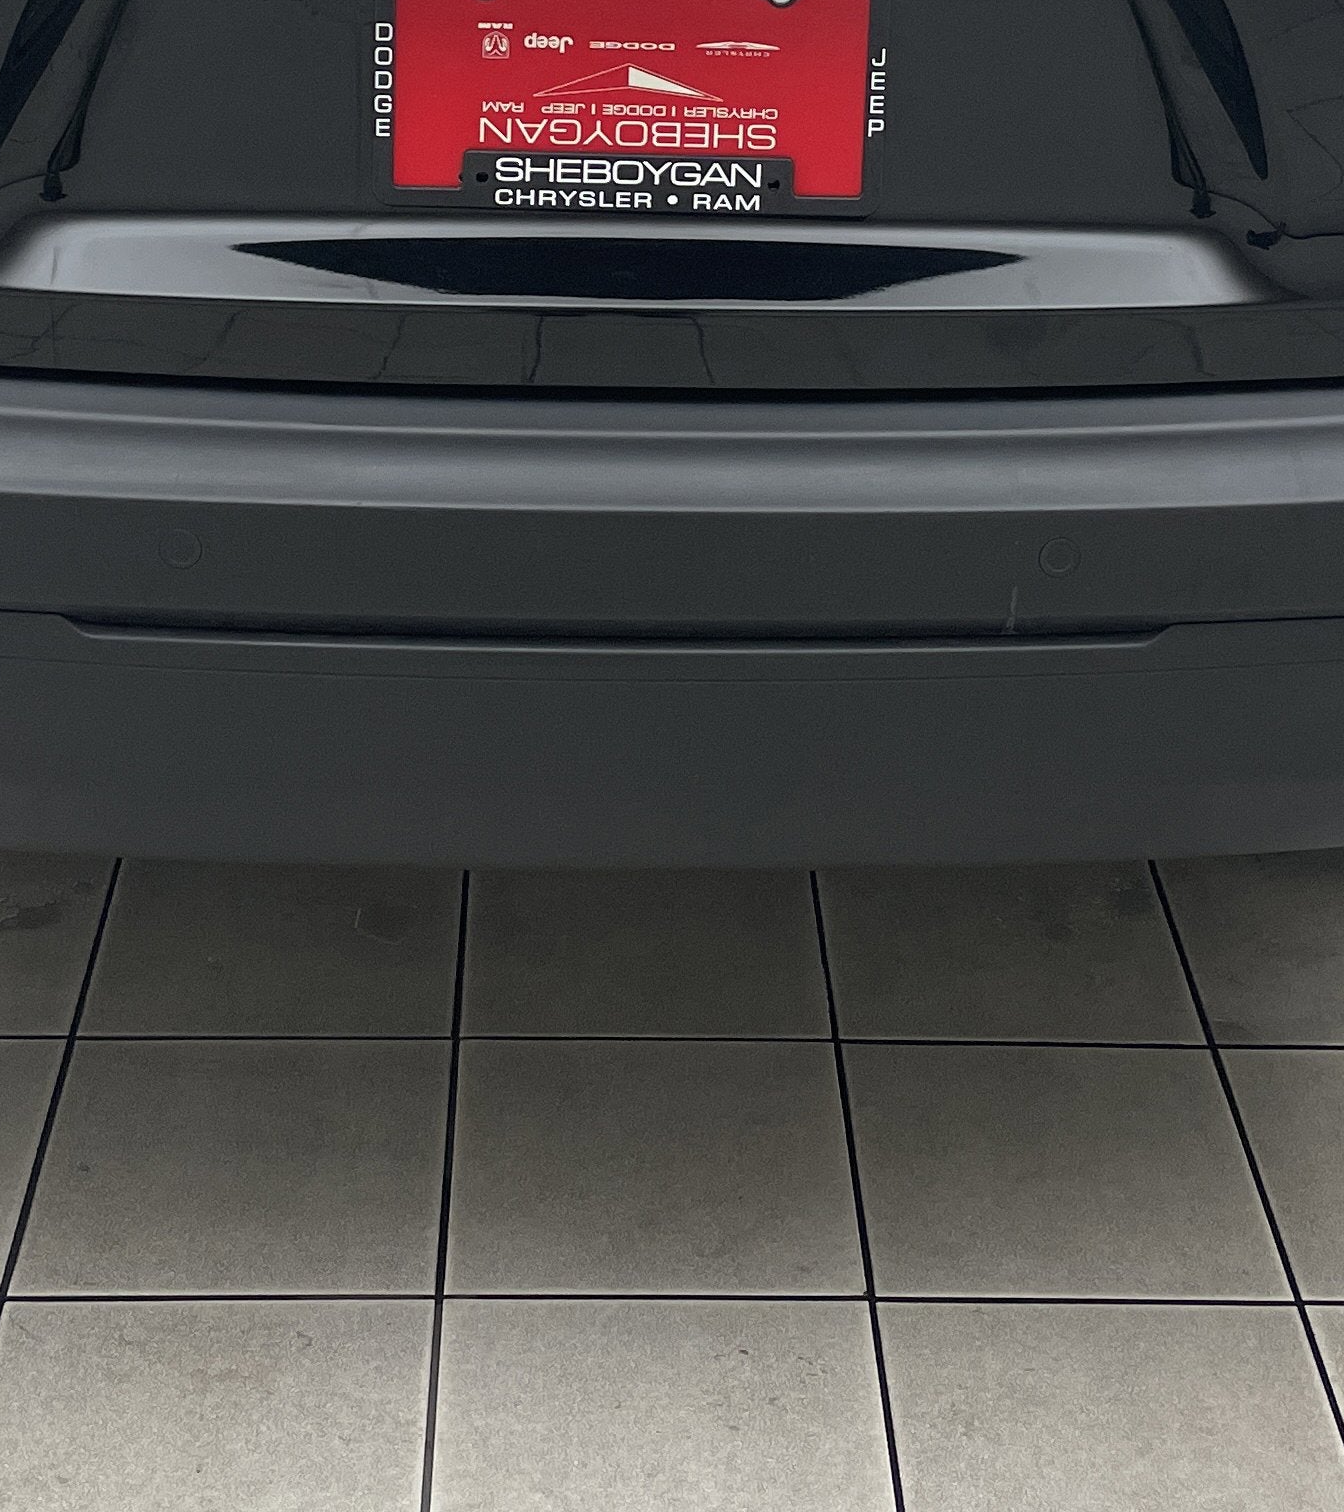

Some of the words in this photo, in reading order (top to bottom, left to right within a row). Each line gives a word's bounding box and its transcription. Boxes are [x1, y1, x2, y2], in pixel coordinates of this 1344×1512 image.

[524, 33, 573, 53] Jeep
[590, 42, 675, 50] DODGE
[374, 23, 393, 137] DODGE
[868, 49, 886, 137] JEEP
[483, 101, 524, 112] RAM
[541, 103, 585, 114] JEEP
[603, 104, 666, 116] DODGE
[684, 107, 778, 119] CHRYSLER
[479, 117, 777, 150] SHEBOYGAN
[495, 157, 762, 188] SHEBOYGAN
[495, 189, 652, 208] CHRYSLER
[693, 194, 760, 210] RAM
